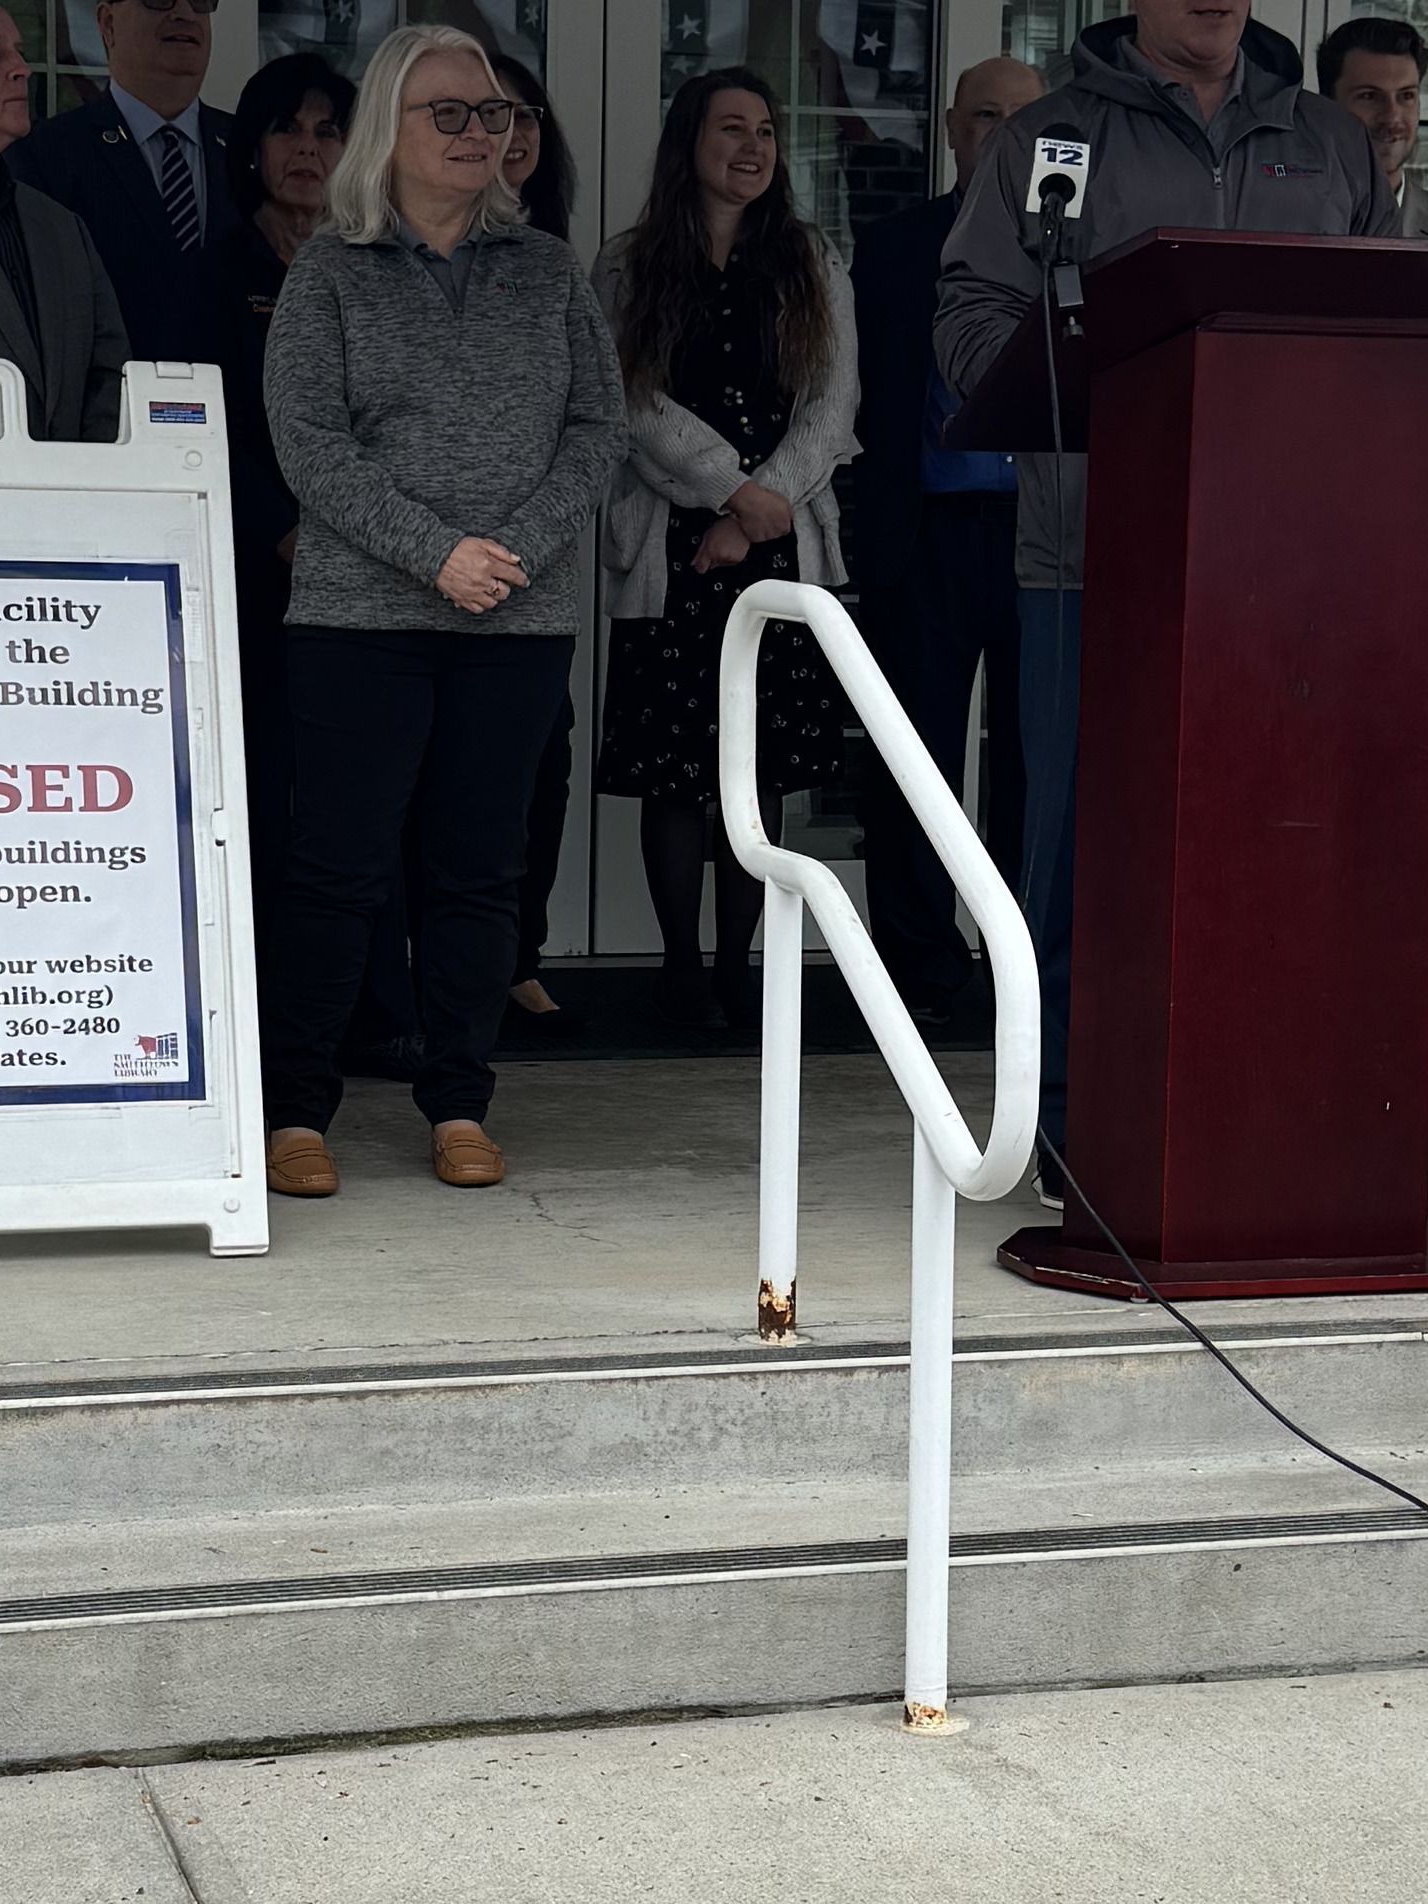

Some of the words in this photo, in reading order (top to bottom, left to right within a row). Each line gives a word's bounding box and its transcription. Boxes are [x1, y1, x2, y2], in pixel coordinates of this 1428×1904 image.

[1041, 147, 1083, 166] 12
[6, 639, 69, 664] the
[0, 680, 164, 714] Building
[45, 954, 153, 973] website
[6, 1017, 120, 1037] 360-2480
